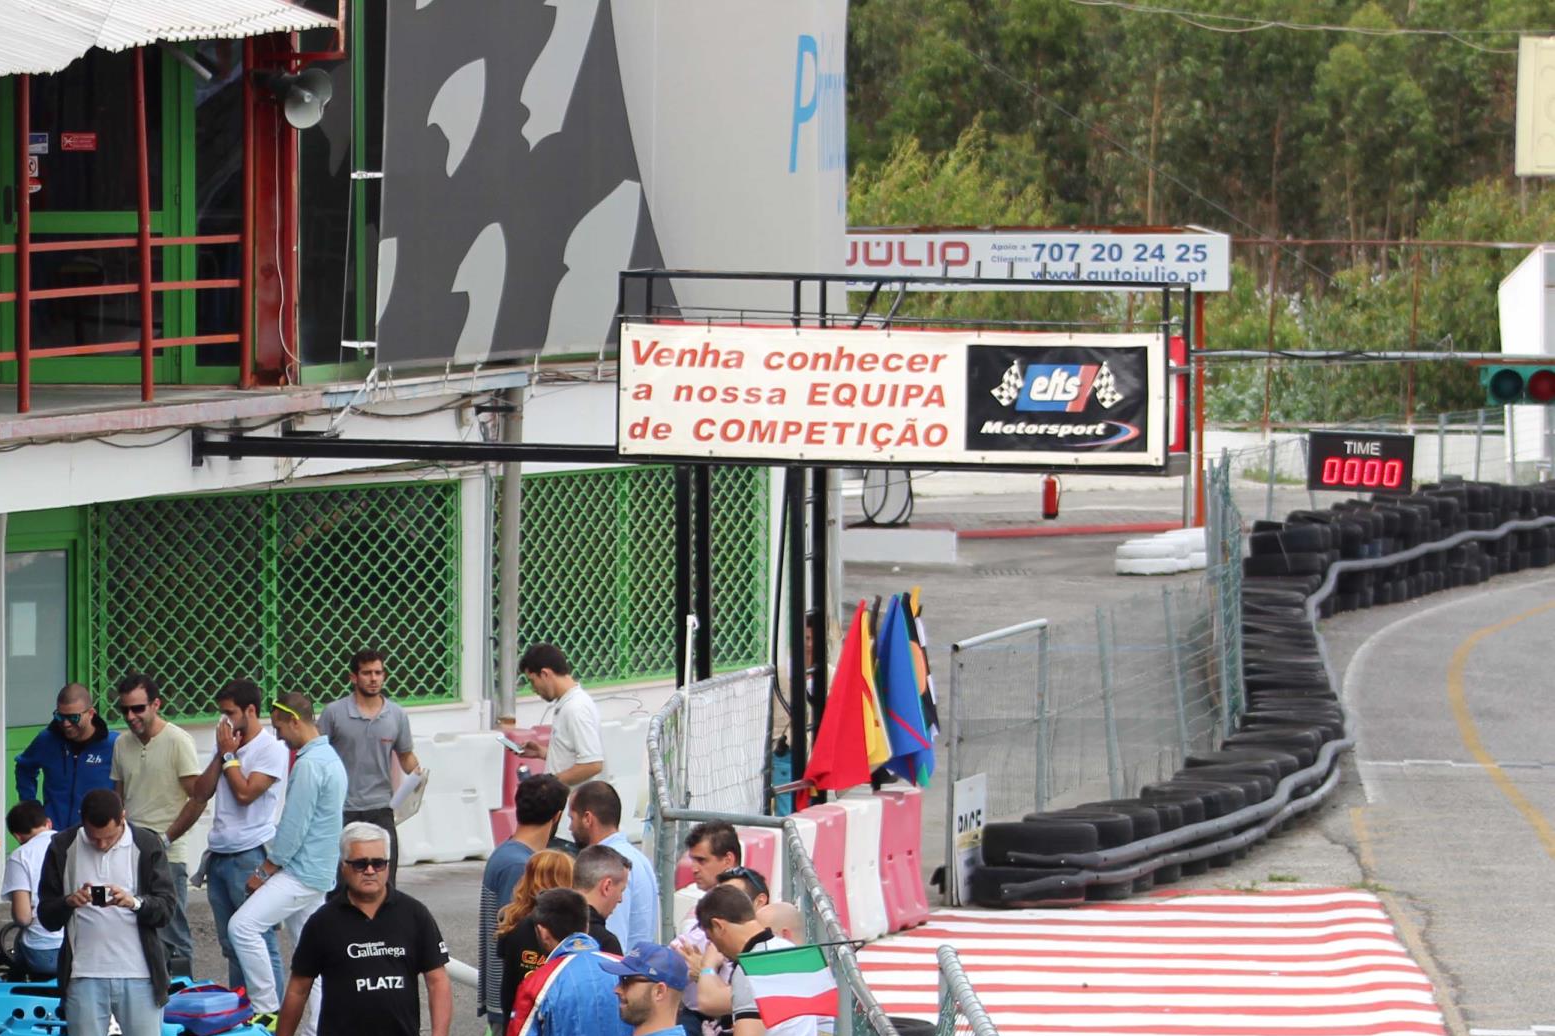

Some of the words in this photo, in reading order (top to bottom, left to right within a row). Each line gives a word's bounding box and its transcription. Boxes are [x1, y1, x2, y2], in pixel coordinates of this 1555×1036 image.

[1032, 243, 1081, 262] 707
[1091, 243, 1123, 262] 20
[1133, 244, 1165, 262] 24
[1175, 244, 1207, 262] 25
[632, 340, 744, 368] Venha
[763, 346, 947, 373] conhecer
[632, 383, 653, 401] a
[673, 384, 787, 405] nossa
[807, 383, 947, 408] EQUIPA
[628, 416, 672, 441] de
[693, 418, 949, 452] COMPETIÇÃO
[980, 421, 1108, 437] Motorsport
[1343, 441, 1382, 456] TIME
[1322, 456, 1404, 487] 0000
